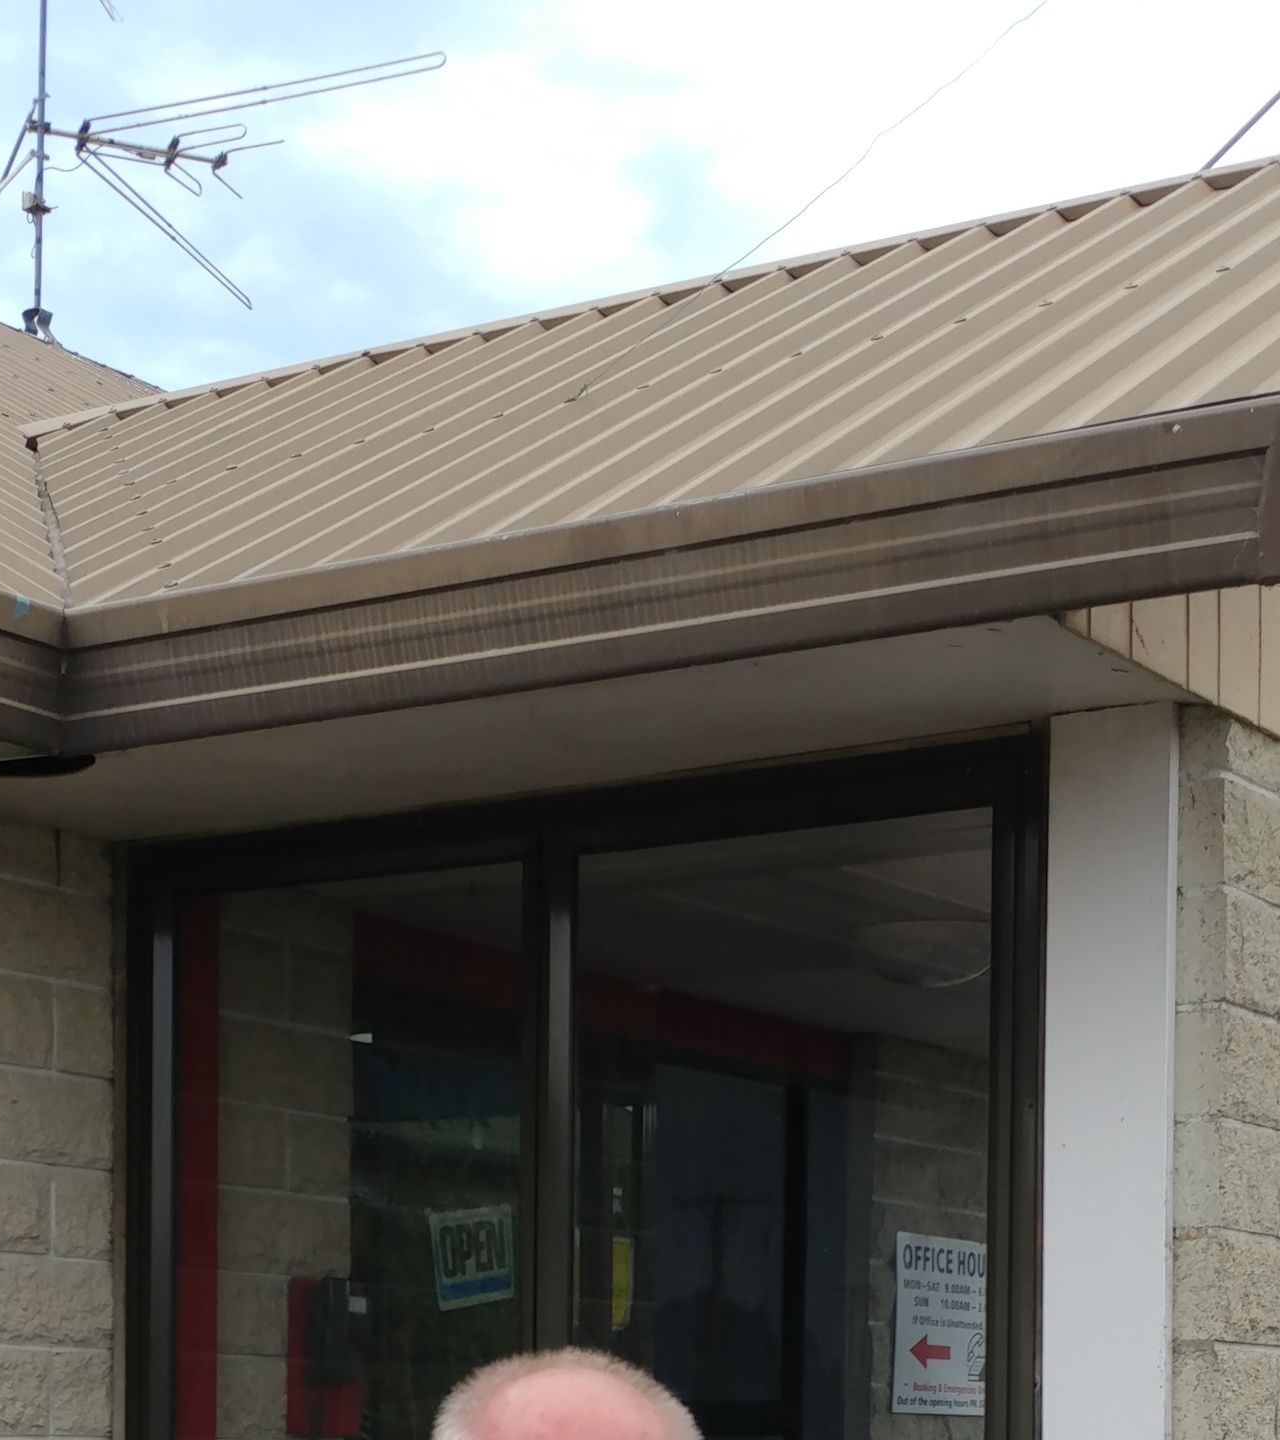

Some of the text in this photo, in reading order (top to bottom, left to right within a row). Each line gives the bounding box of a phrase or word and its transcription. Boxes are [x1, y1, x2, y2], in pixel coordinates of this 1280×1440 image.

[439, 1219, 508, 1278] OPEN
[903, 1243, 953, 1274] OFFICE
[914, 1296, 929, 1308] SUN
[940, 1298, 970, 1311] 10.00AM
[919, 1315, 939, 1327] Office
[897, 1396, 908, 1406] Out
[909, 1396, 917, 1406] of
[918, 1396, 928, 1406] the
[929, 1397, 952, 1409] opening
